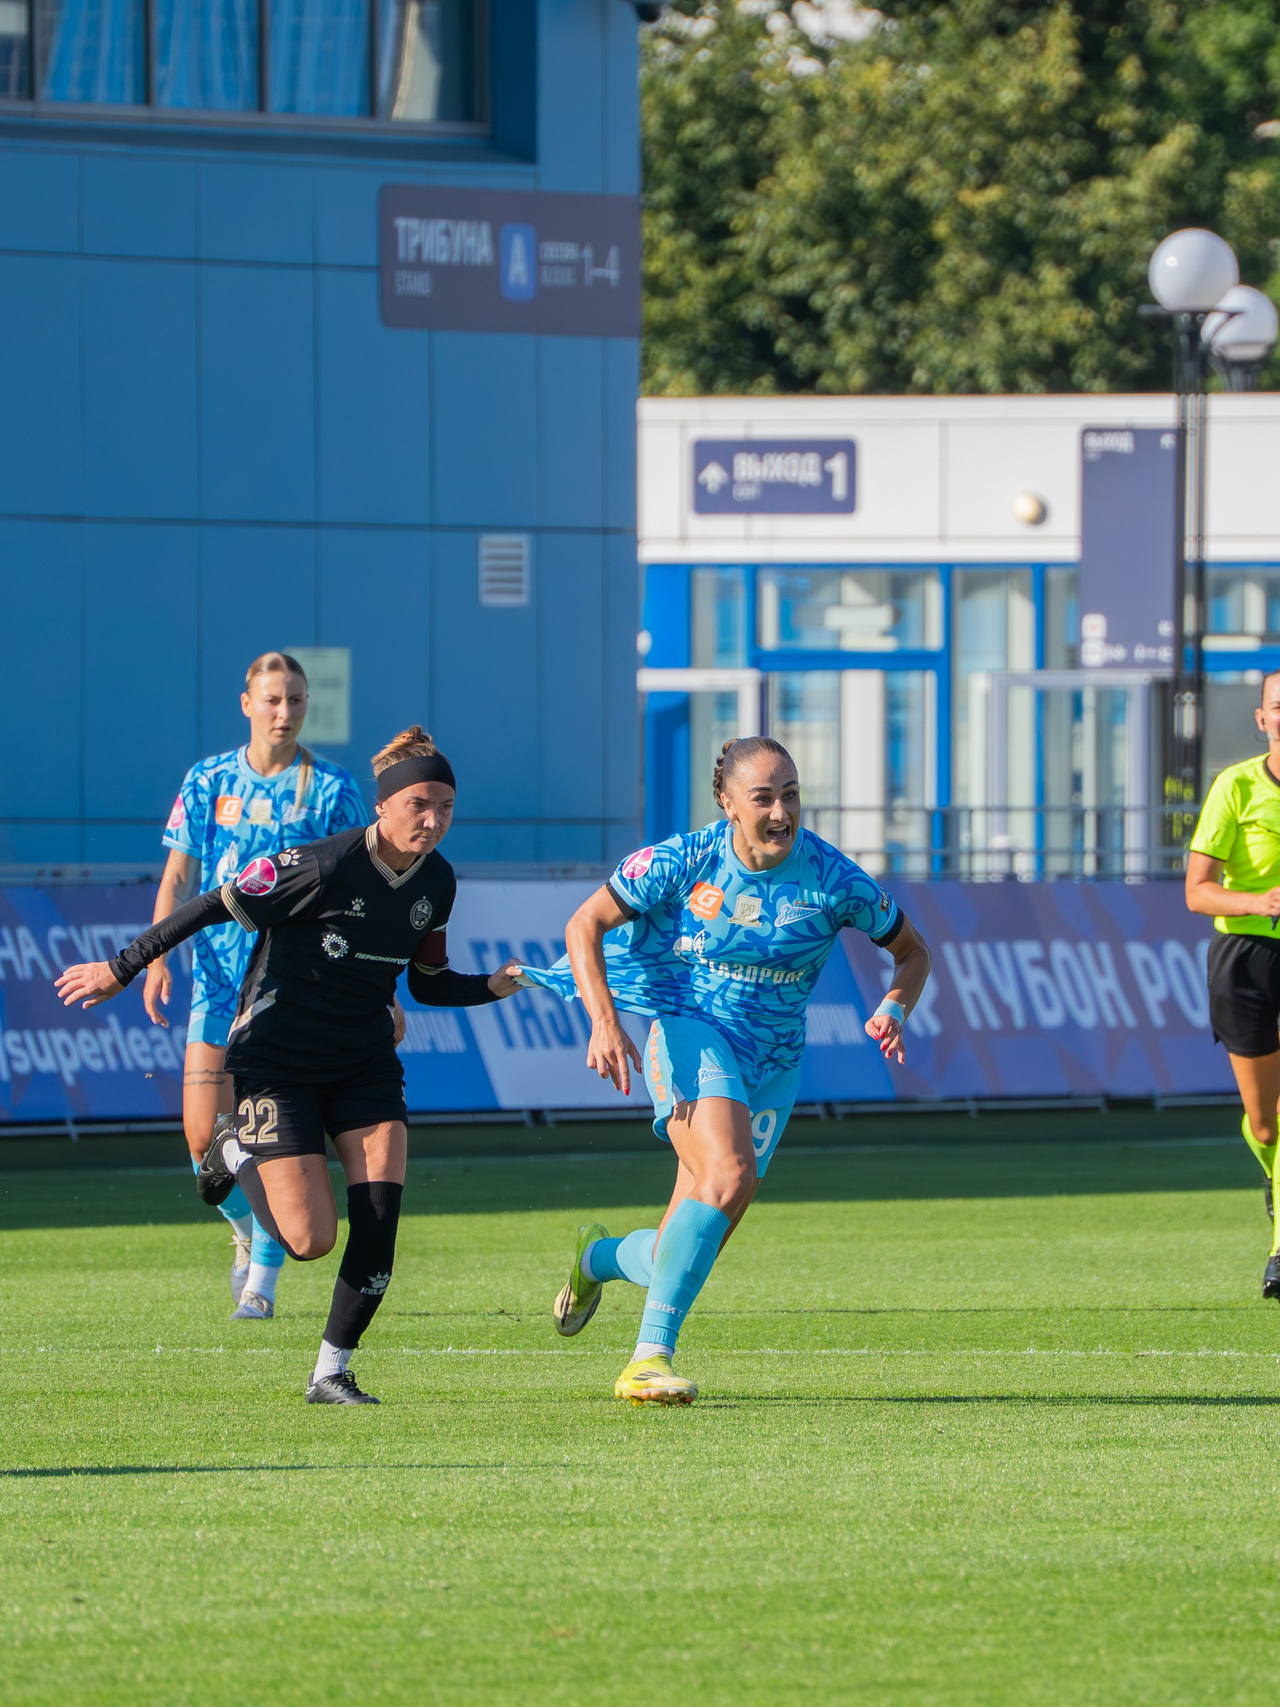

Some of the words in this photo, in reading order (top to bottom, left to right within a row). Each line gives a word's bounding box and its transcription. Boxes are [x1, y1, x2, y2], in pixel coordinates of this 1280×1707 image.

[393, 216, 495, 266] ТРИБУНА
[732, 452, 822, 488] ВЫХОД
[824, 451, 848, 501] 1
[344, 910, 366, 918] KELME
[237, 1098, 279, 1145] 22
[749, 1108, 777, 1158] 9
[646, 1300, 684, 1318] ЗЕНИТ
